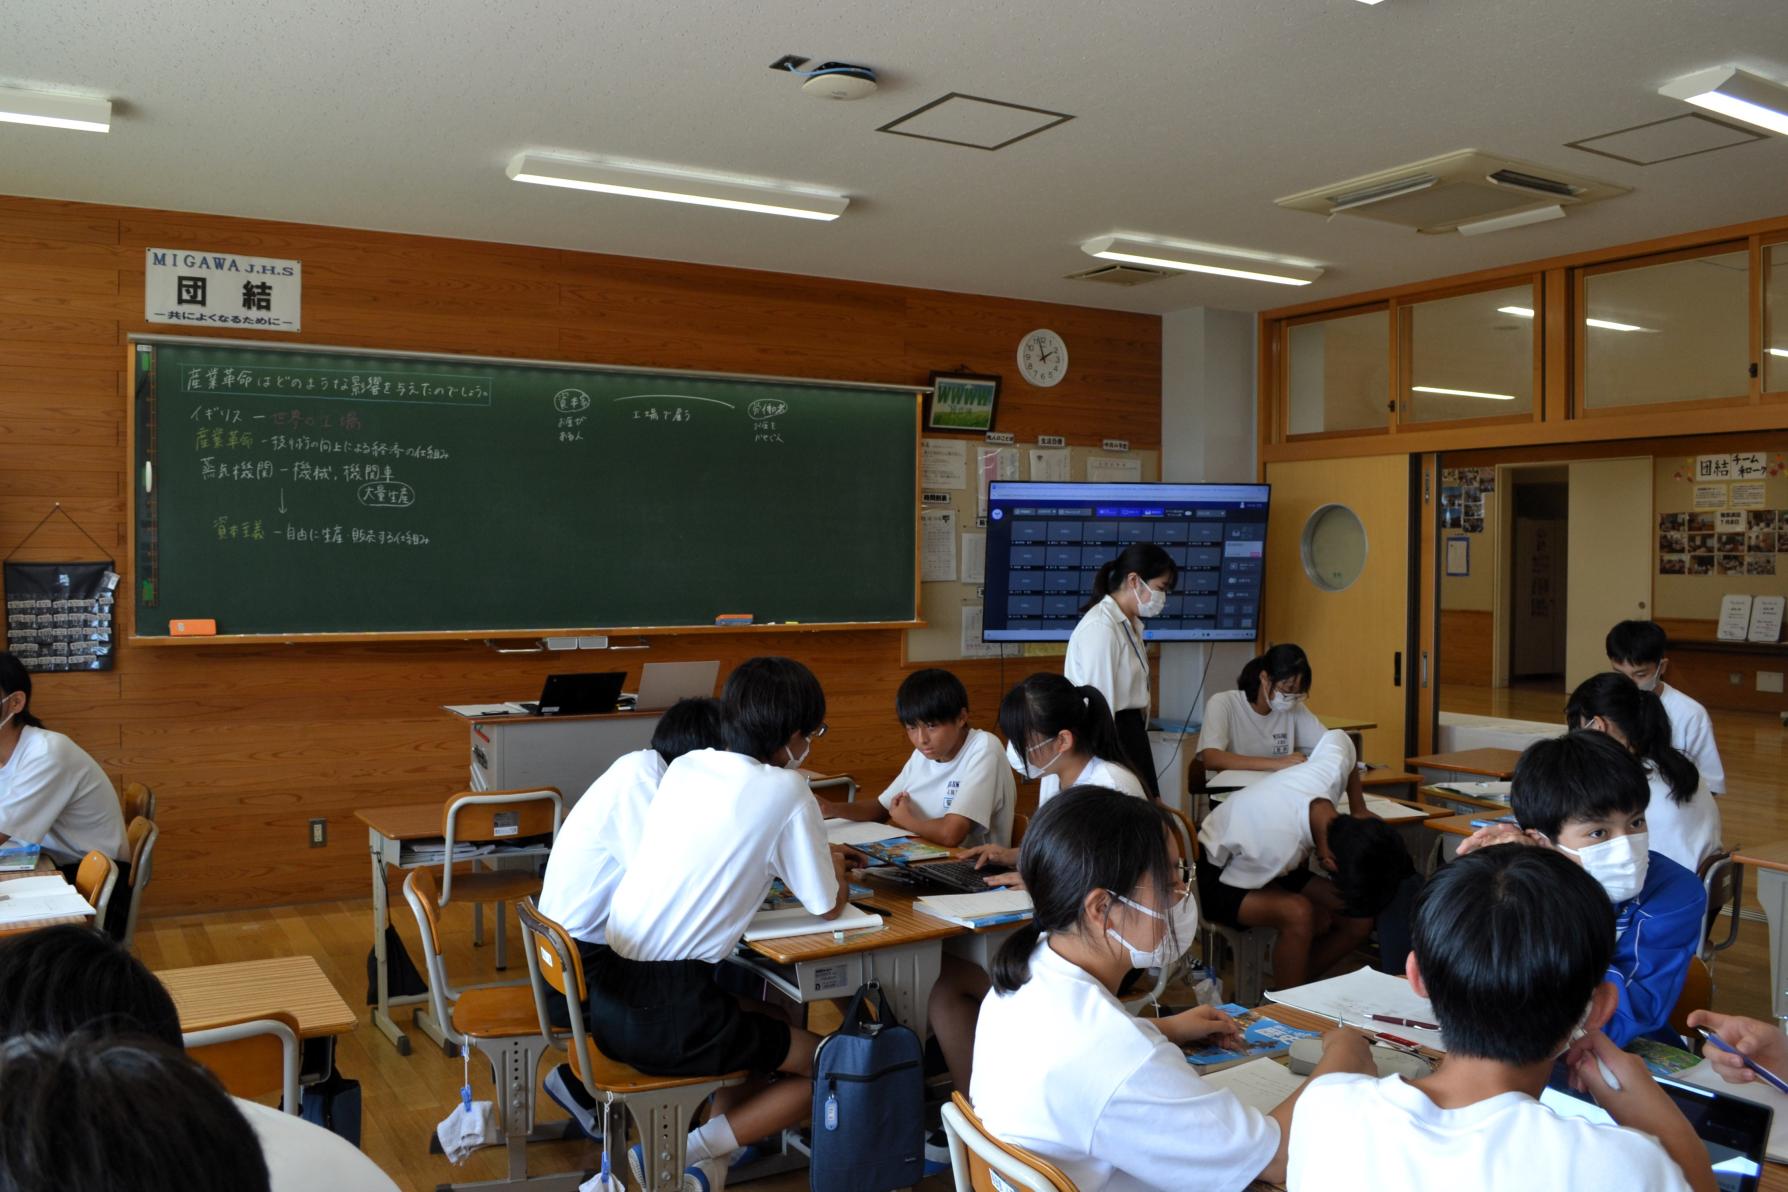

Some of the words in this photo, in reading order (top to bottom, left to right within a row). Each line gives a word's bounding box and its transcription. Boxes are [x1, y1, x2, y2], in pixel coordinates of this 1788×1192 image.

[153, 252, 240, 272] MIGAWA
[245, 263, 294, 277] J.H.S
[177, 275, 273, 312] 団結
[190, 405, 242, 423] イギリス
[1701, 460, 1729, 477] 団結
[1732, 454, 1759, 465] チーム
[363, 484, 409, 504] 大量生産
[213, 516, 265, 541] 資本主義
